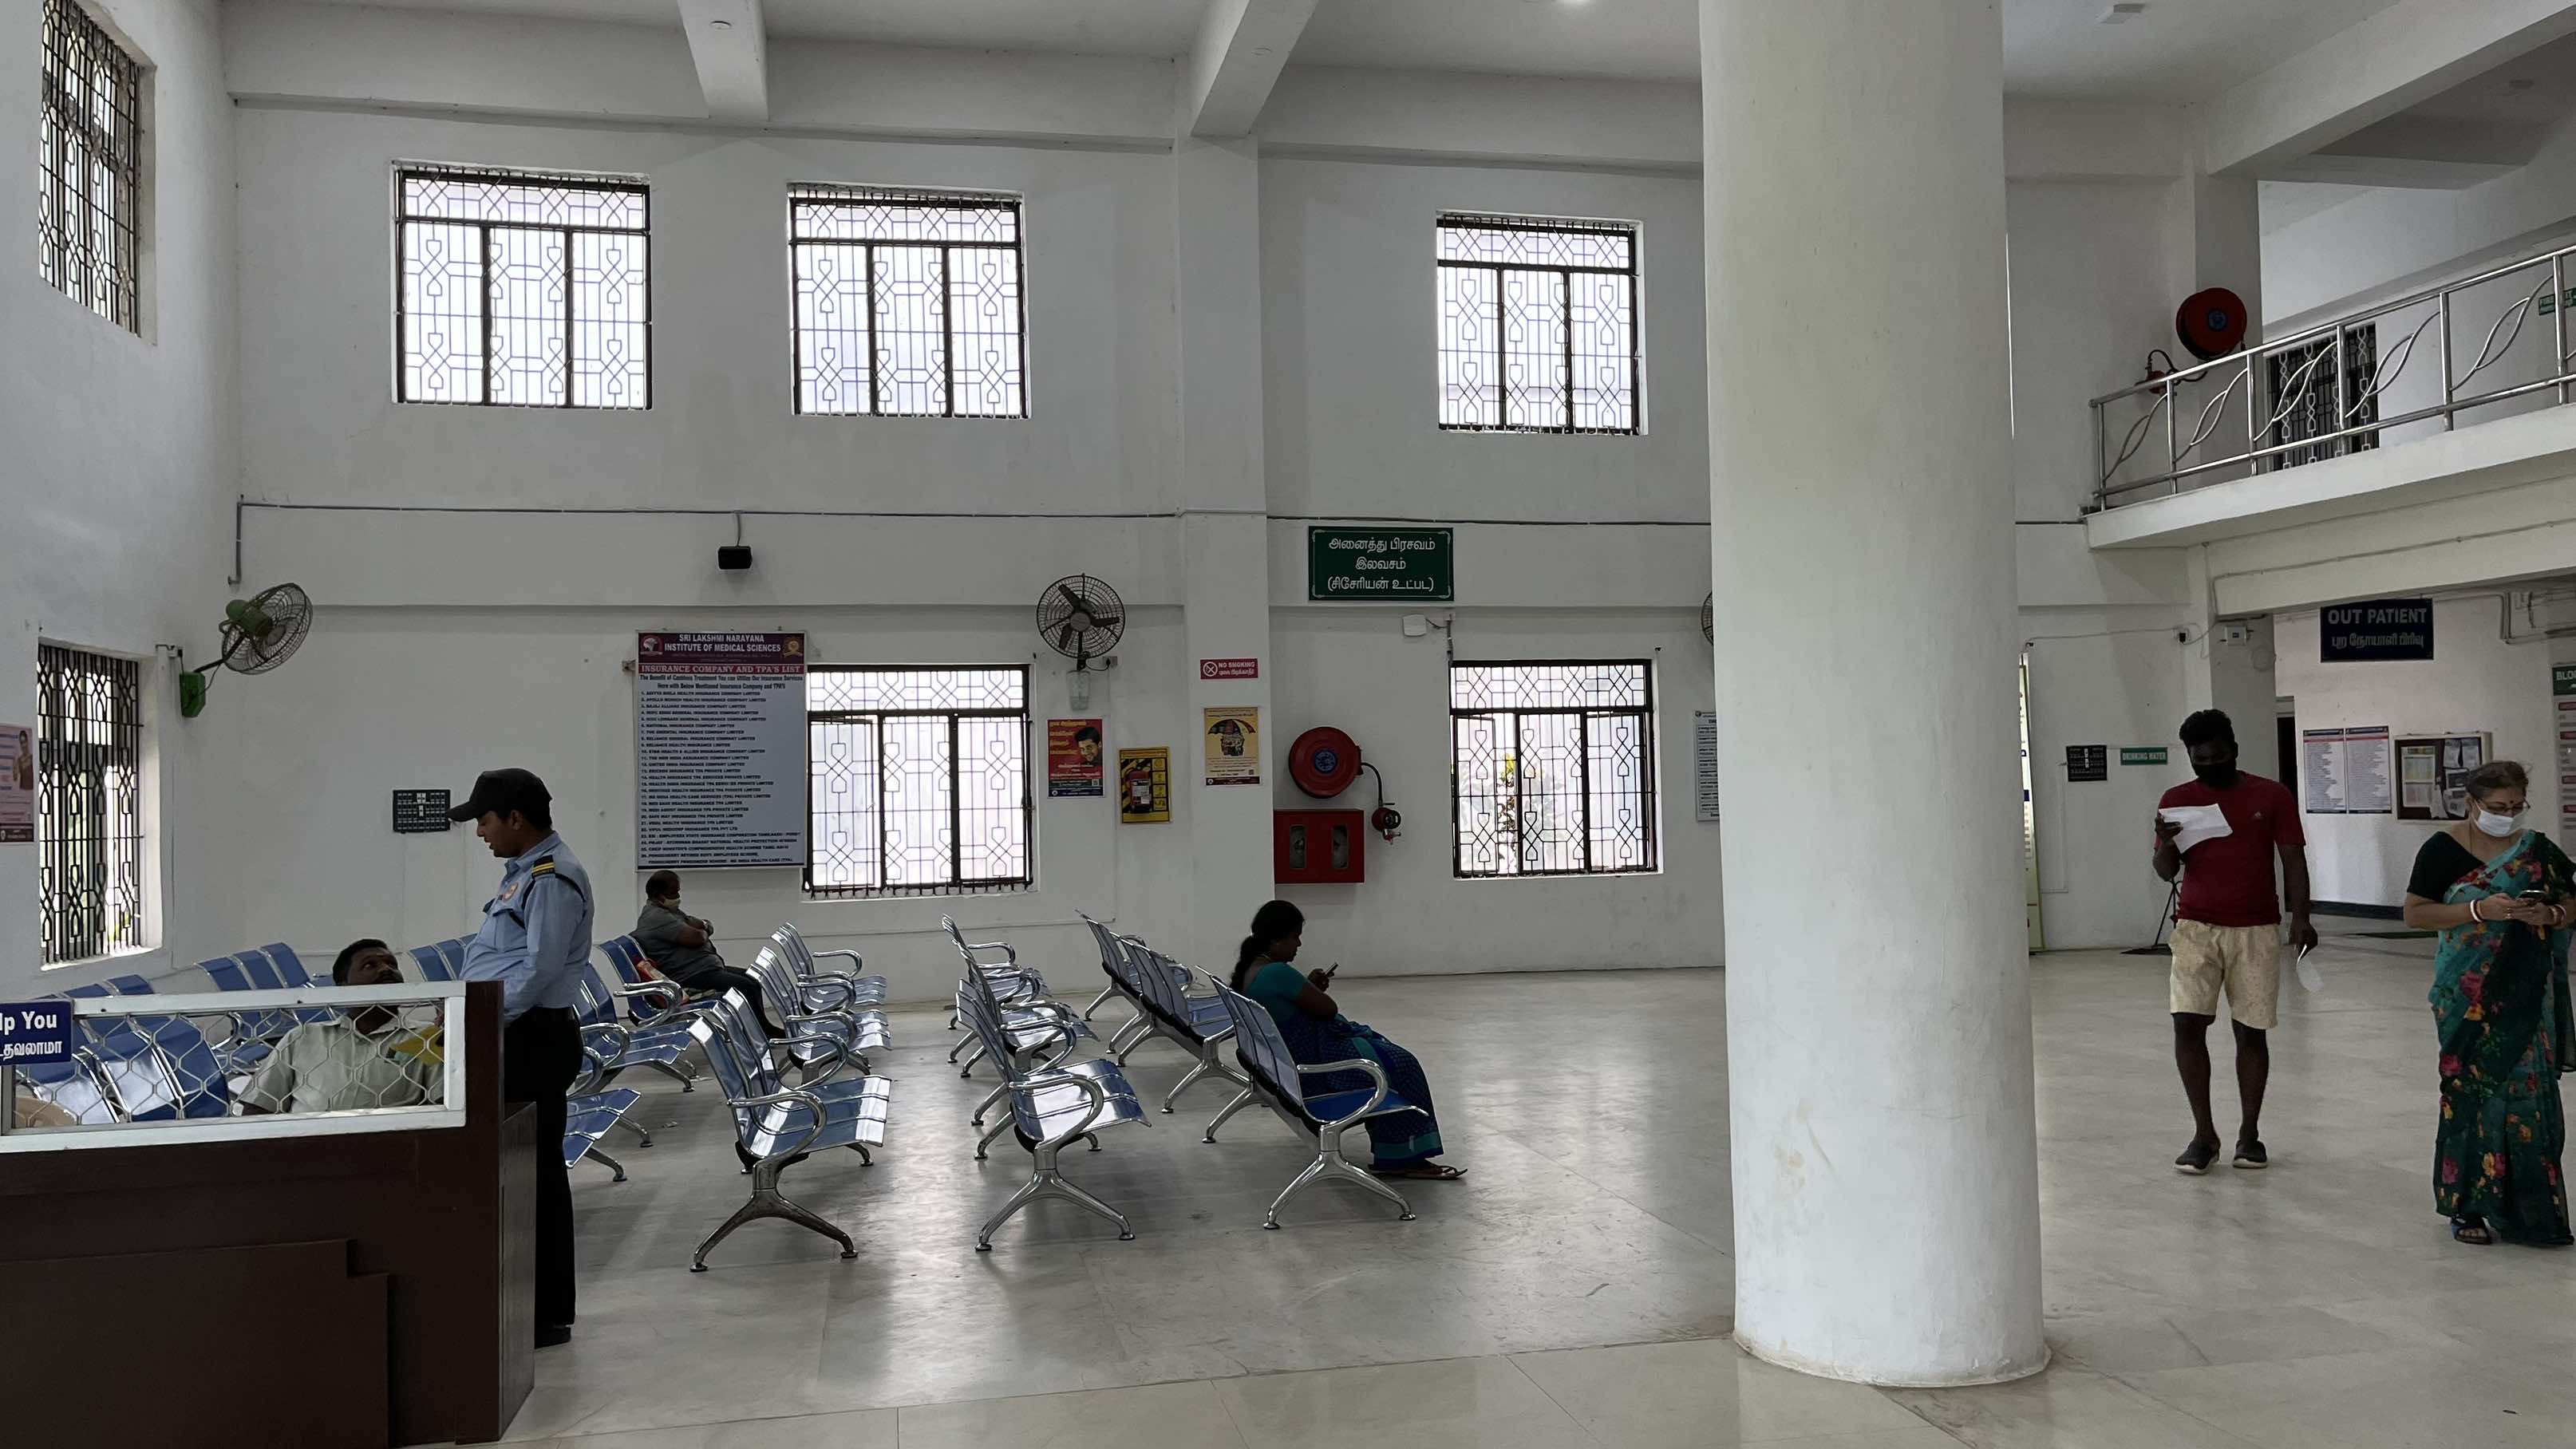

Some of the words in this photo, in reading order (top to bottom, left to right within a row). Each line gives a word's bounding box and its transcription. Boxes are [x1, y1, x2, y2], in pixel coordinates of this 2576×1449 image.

[1329, 537, 1387, 553] அனைத்து
[1391, 537, 1436, 551] பிரசவம்
[1356, 556, 1406, 570] இலவசம்
[1328, 576, 1389, 591] (சிசேரியன்
[1393, 577, 1434, 591] உட்பட)
[2328, 609, 2362, 624] OUT
[2367, 608, 2427, 624] PATIENT
[664, 643, 702, 652] INSTITUTE
[703, 643, 713, 652] OF
[714, 643, 745, 652] MEDICAL
[21, 1011, 57, 1029] You
[0, 1040, 62, 1061] தவலாமா
